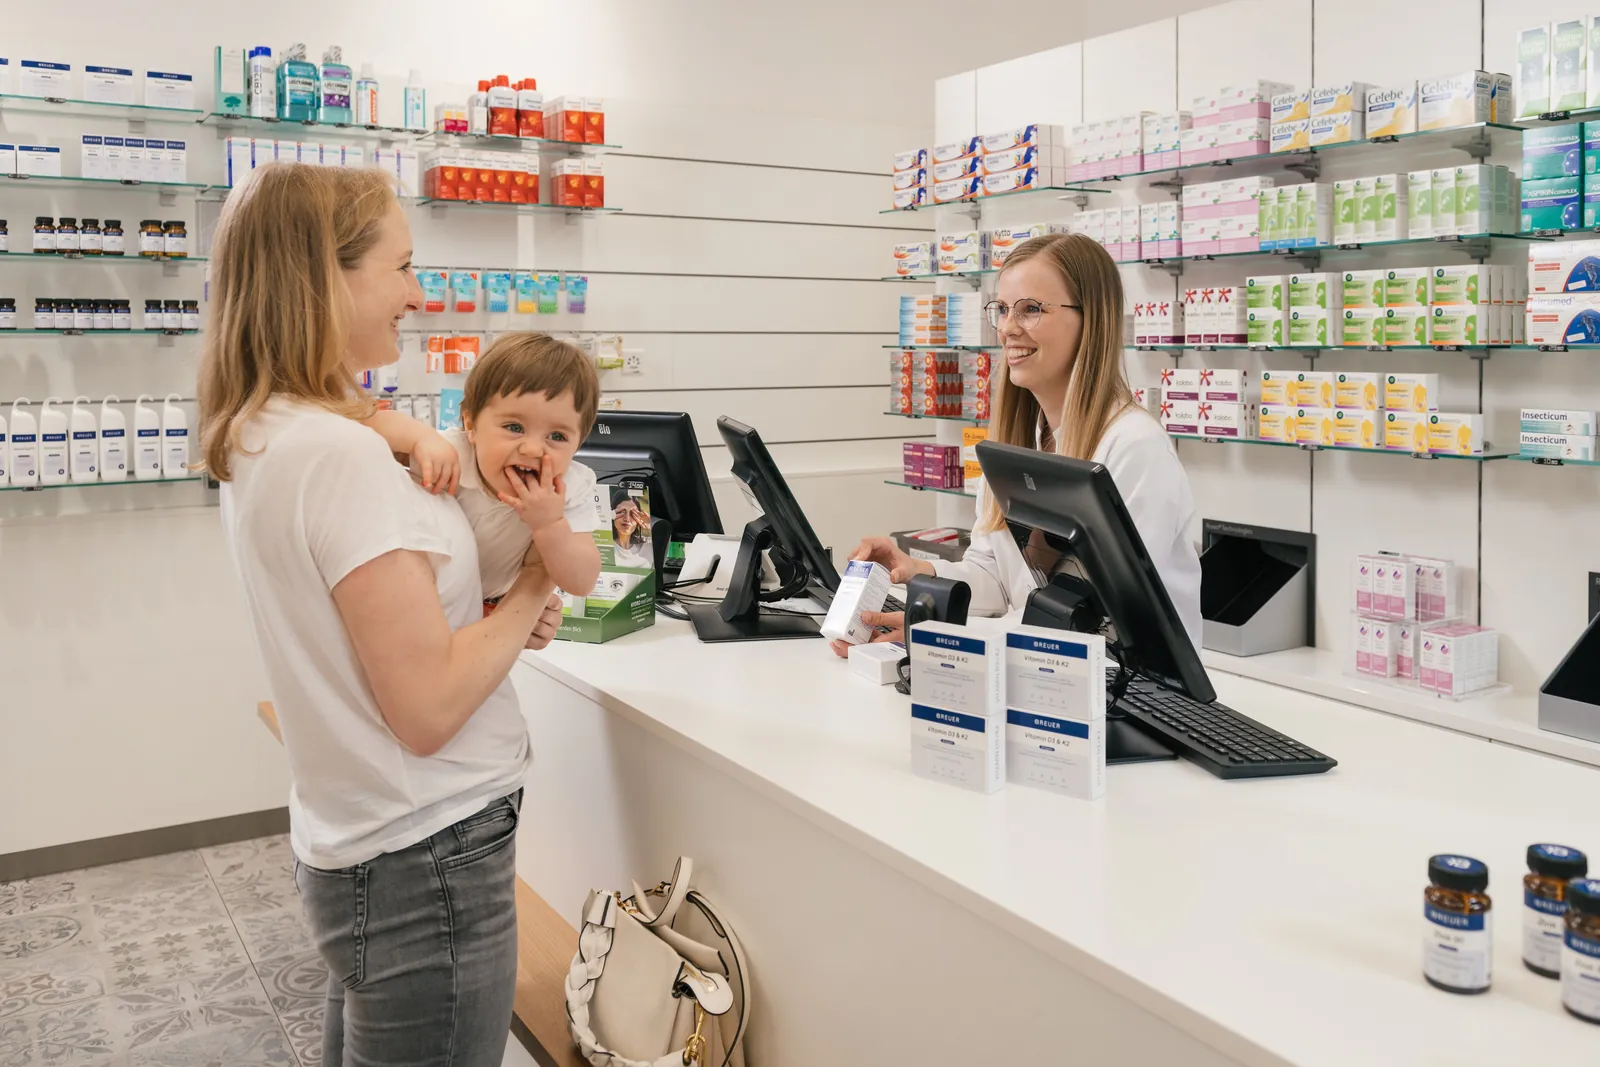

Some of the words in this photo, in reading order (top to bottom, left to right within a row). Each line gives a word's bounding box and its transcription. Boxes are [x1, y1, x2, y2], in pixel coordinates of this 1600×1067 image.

[1522, 411, 1568, 421] Insecticum
[1522, 434, 1567, 445] Insecticum
[935, 637, 960, 647] BREUER
[1033, 641, 1060, 650] BREUER
[927, 651, 948, 660] Vitamin
[1024, 654, 1046, 664] Vitamin
[935, 712, 960, 723] BREUER
[1034, 718, 1061, 729] BREUER
[927, 726, 948, 736] Vitamin
[1025, 731, 1047, 742] Vitamin
[1062, 739, 1070, 747] K2
[1430, 911, 1469, 926] BREUER
